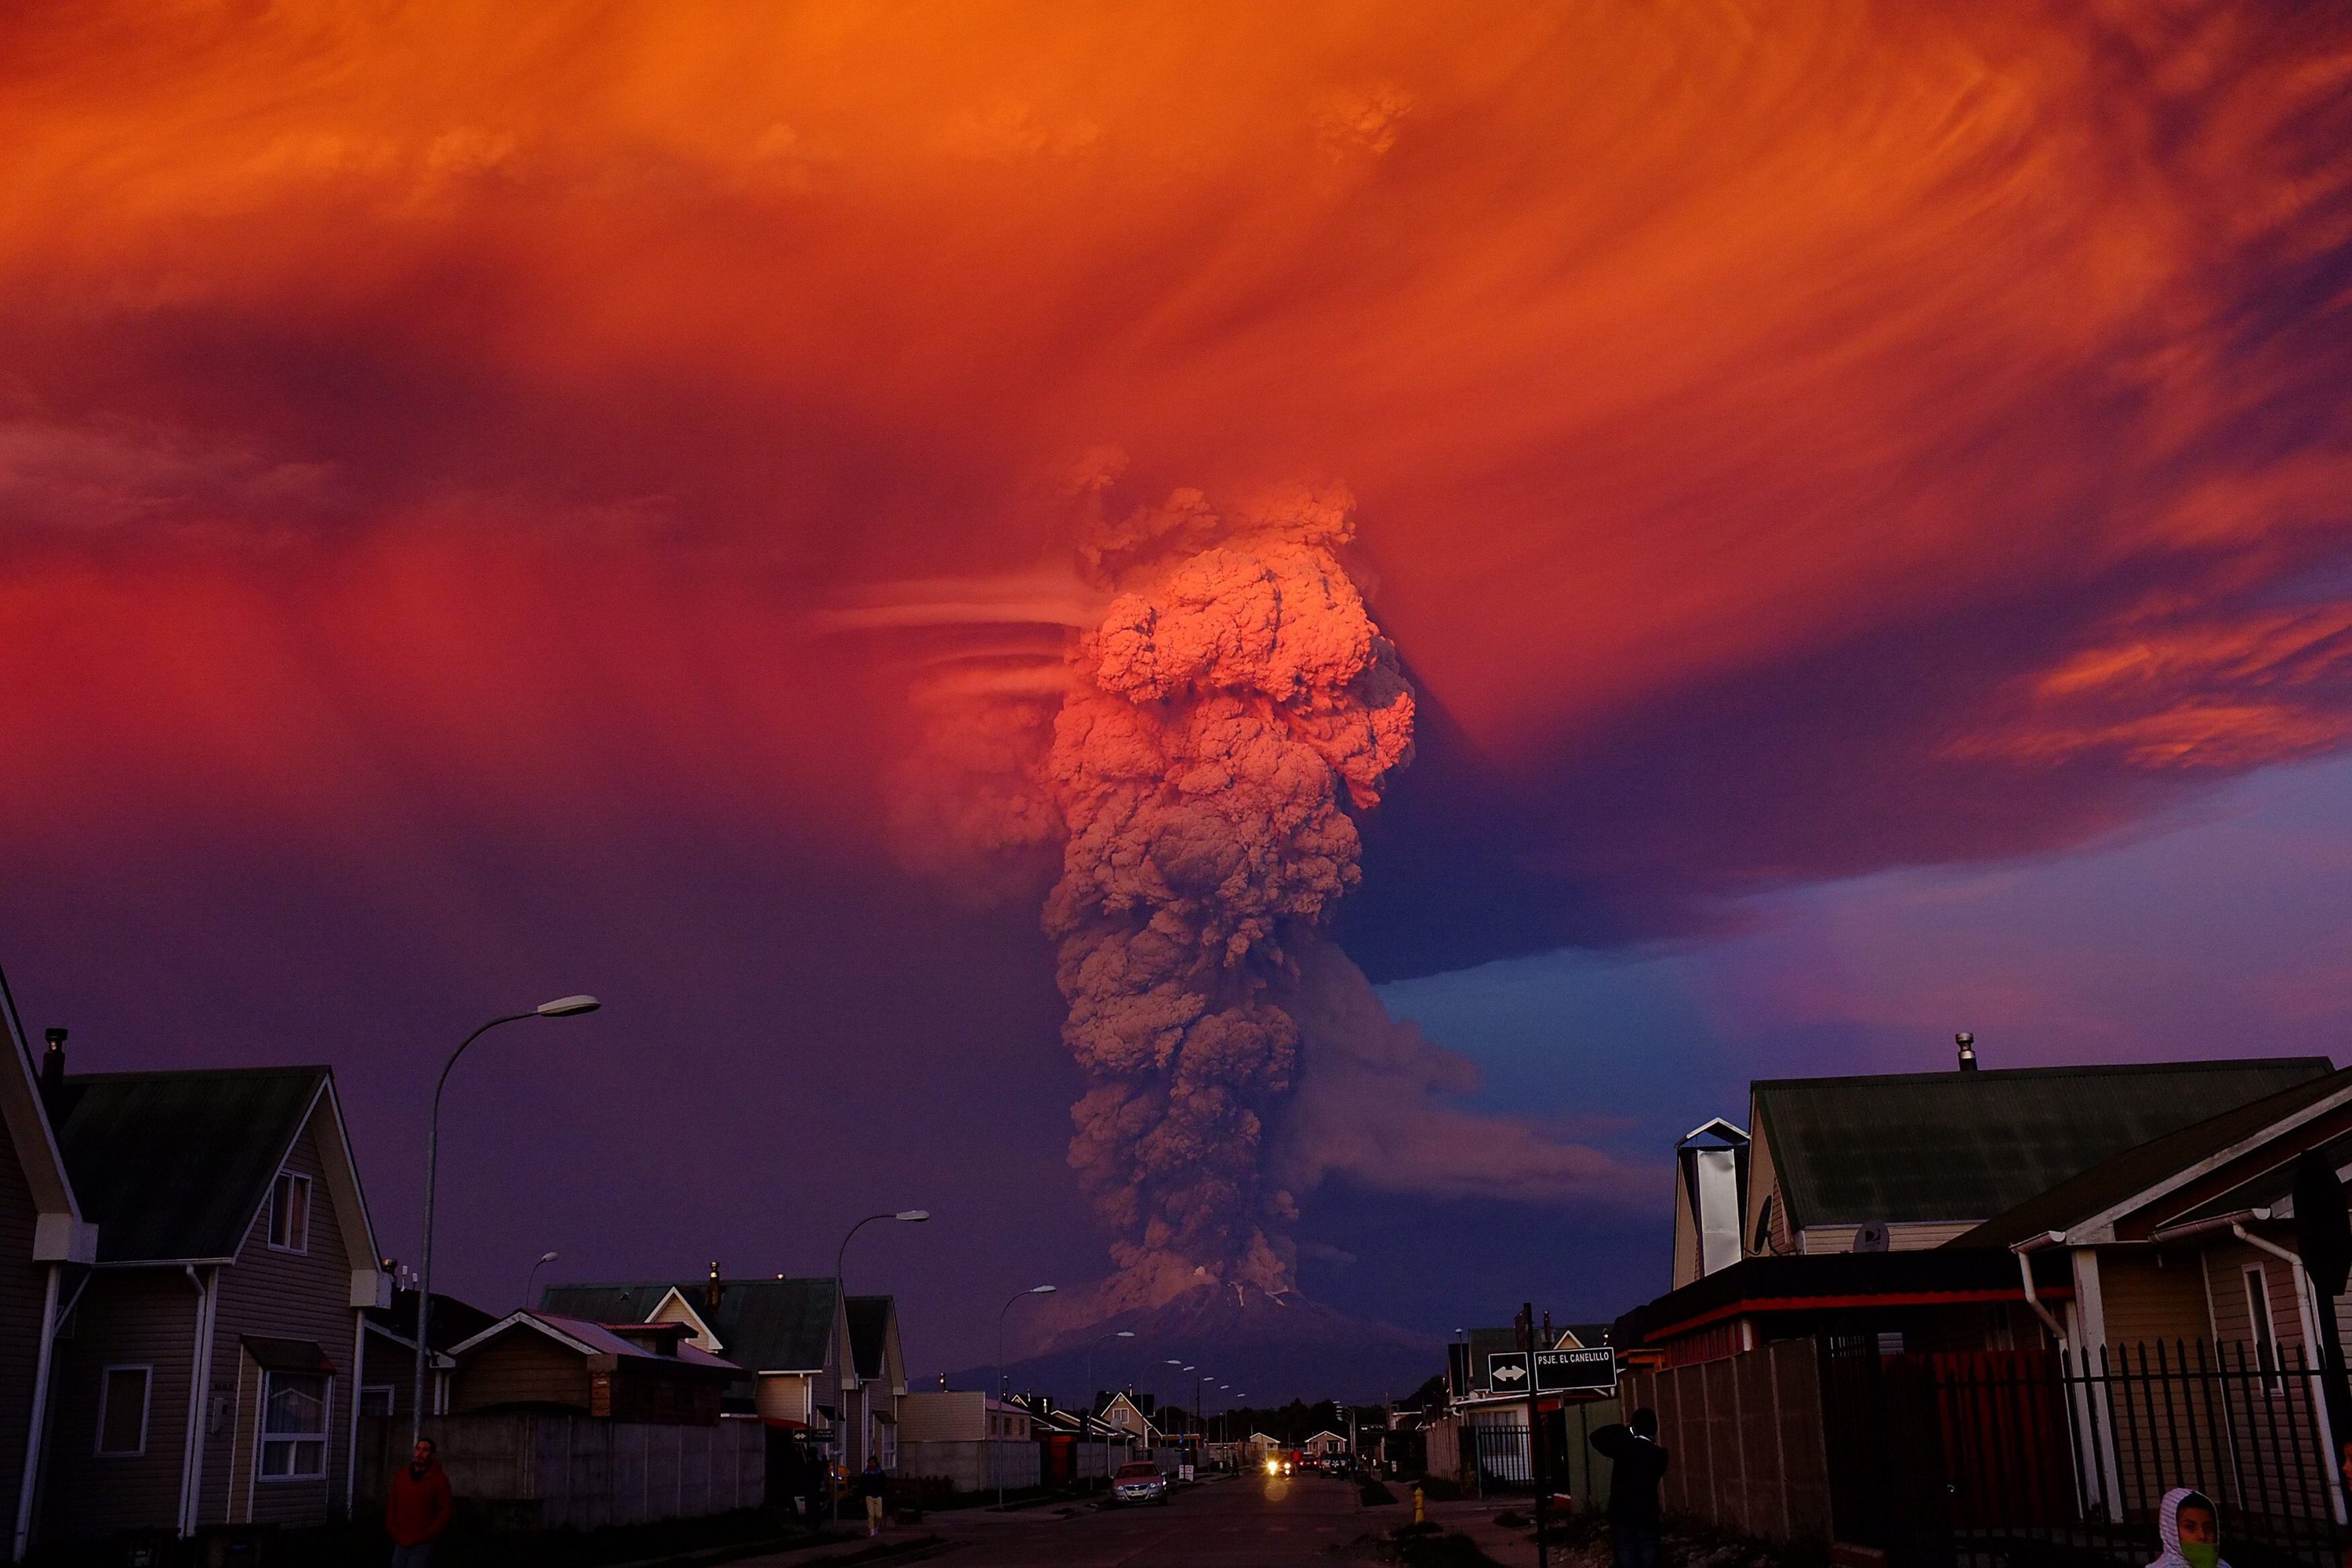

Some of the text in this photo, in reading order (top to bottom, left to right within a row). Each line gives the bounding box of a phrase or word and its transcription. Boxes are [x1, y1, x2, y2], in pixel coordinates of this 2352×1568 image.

[1538, 1352, 1609, 1365] PSJE. EL CANELILLO
